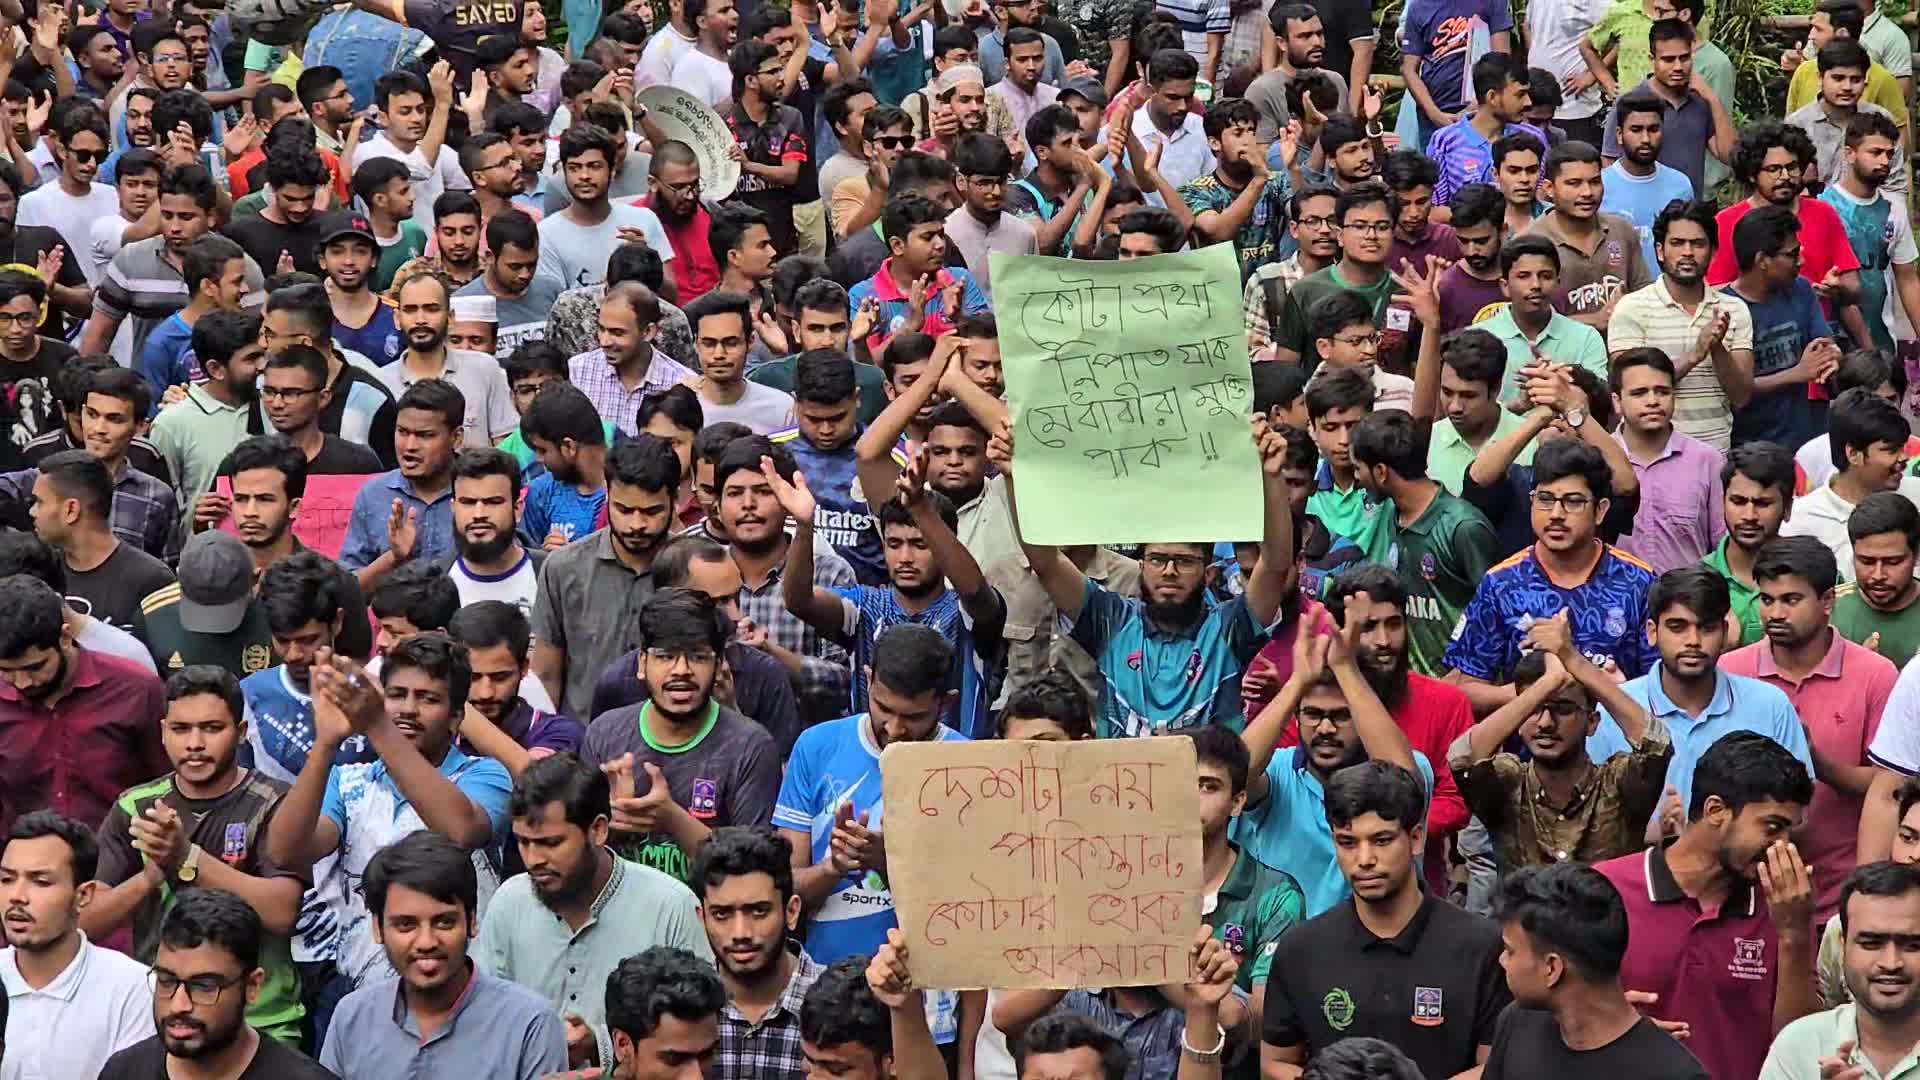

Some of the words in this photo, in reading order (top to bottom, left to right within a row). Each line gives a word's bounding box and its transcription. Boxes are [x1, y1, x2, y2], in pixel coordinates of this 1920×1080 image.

[456, 3, 516, 25] SAYED
[1017, 273, 1124, 351] কোটা
[1132, 280, 1220, 321] প্রথা
[1040, 340, 1170, 395] নিপাত
[1177, 334, 1239, 368] যাক
[1026, 382, 1188, 448] মেধাবীরা
[1191, 373, 1251, 420] মুক্তি
[1083, 437, 1188, 479] পাক
[919, 745, 1062, 827] দেশটা
[1090, 762, 1167, 812] নয়
[925, 872, 1056, 946] কোটার
[1088, 891, 1184, 935] হোক
